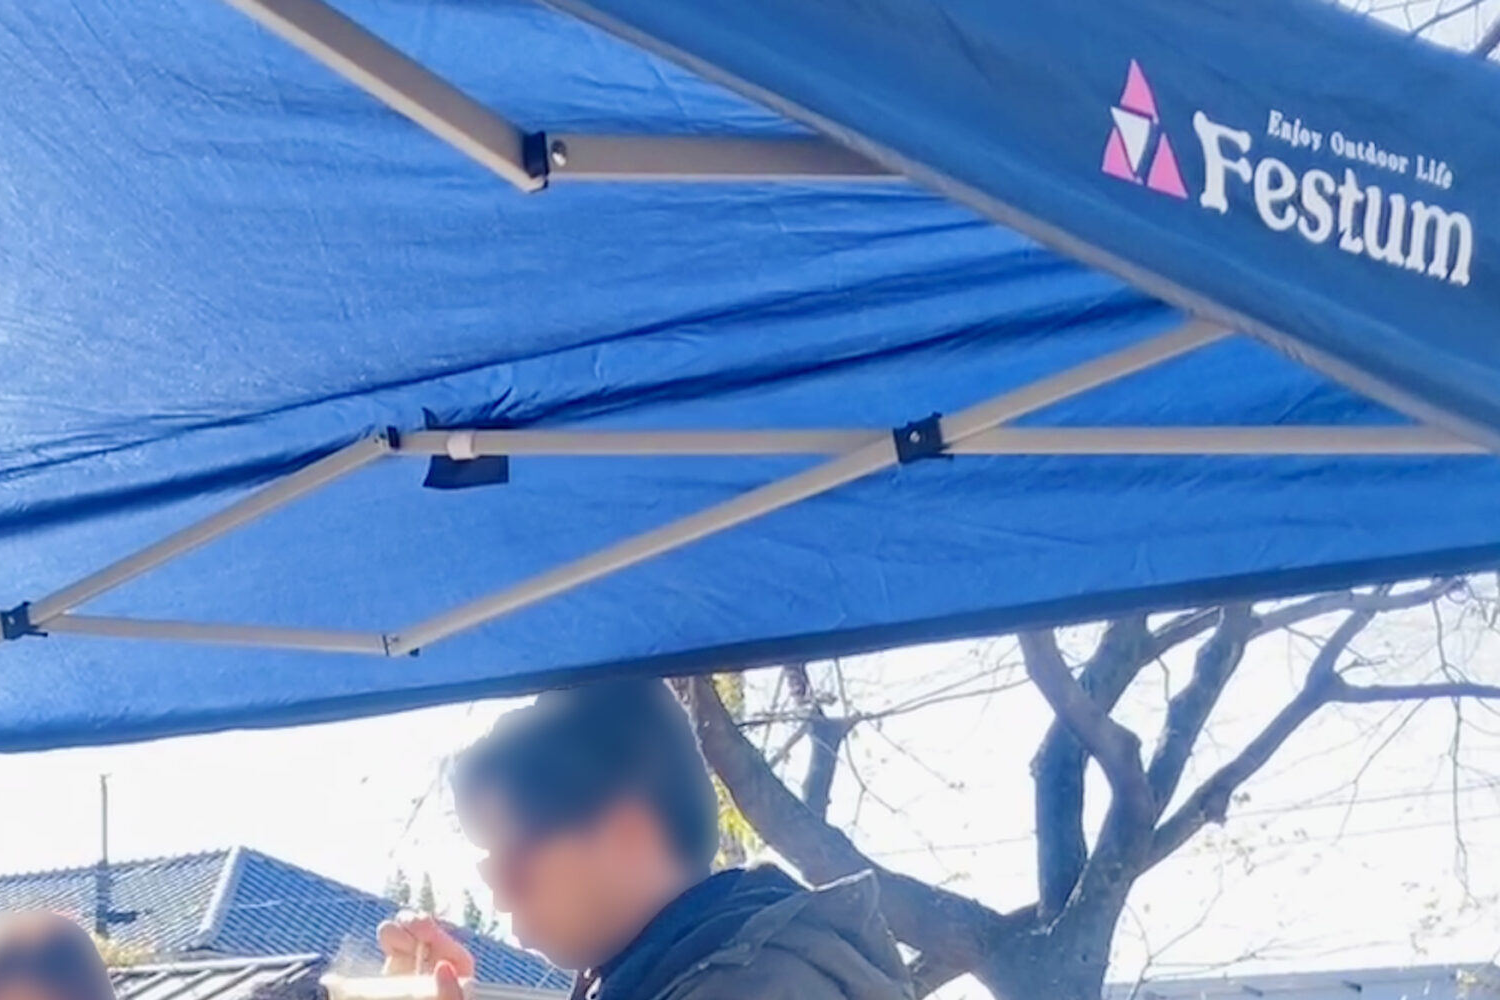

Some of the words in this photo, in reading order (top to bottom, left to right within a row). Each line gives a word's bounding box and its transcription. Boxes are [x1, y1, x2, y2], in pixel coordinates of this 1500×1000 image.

[1193, 110, 1474, 287] Festum
[1267, 109, 1323, 151] Enjoy
[1330, 131, 1409, 173] Outdoor
[1416, 154, 1453, 189] Life
